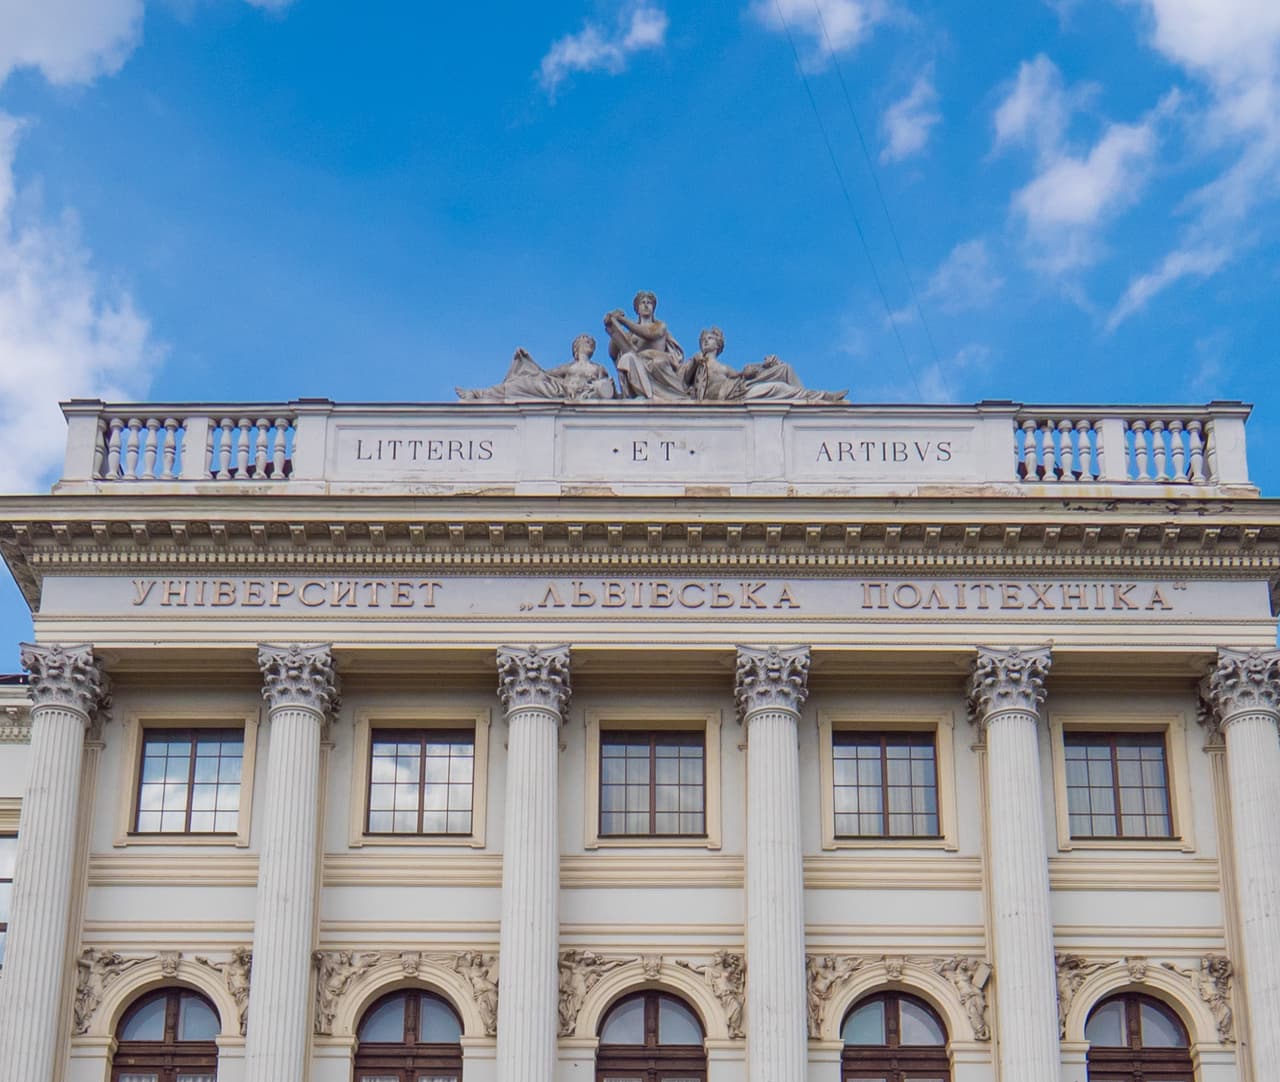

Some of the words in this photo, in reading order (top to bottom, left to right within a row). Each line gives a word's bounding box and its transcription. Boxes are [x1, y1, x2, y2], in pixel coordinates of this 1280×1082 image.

[356, 439, 495, 461] LITTERIS
[816, 441, 952, 462] ARTIBVS
[132, 579, 443, 608] УНІВЕРСИТЕТ
